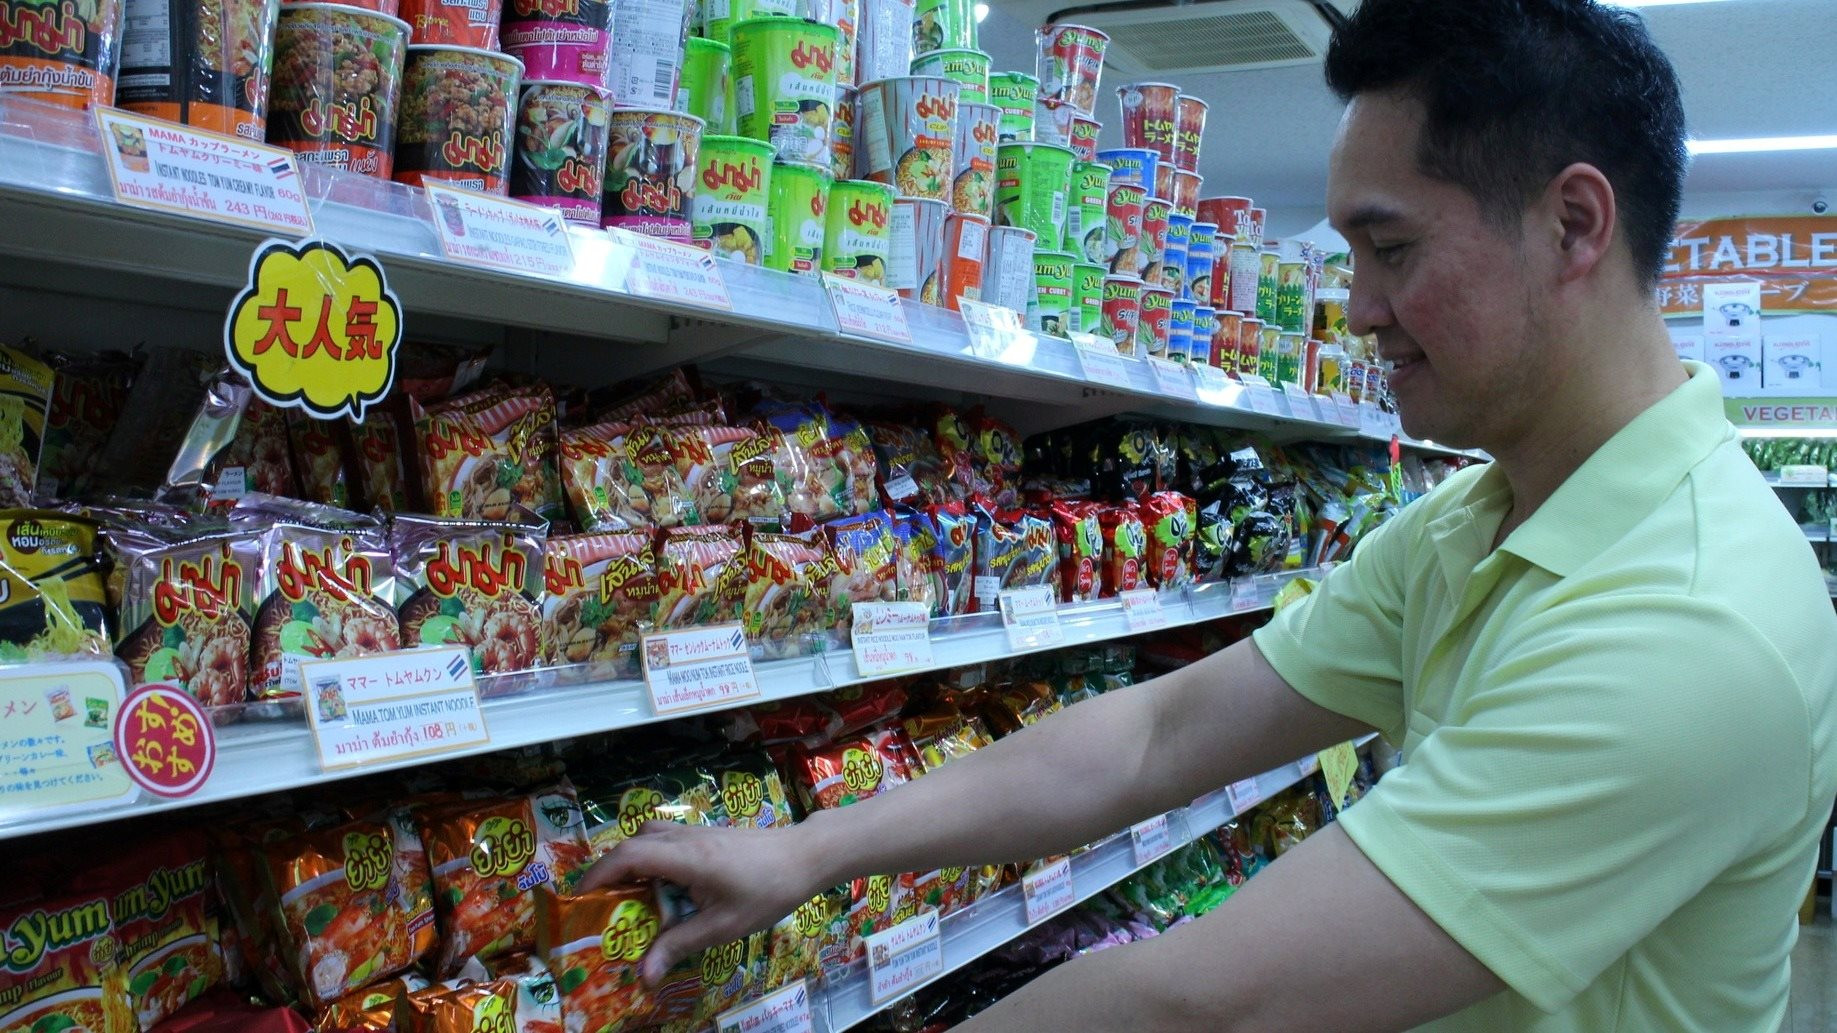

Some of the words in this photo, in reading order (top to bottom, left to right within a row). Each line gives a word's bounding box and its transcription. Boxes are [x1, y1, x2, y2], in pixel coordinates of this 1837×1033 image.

[148, 127, 187, 144] MAMA
[703, 156, 762, 193] มาม่า
[225, 200, 251, 216] 243
[252, 287, 384, 362] 大人気
[1744, 404, 1837, 422] VEGETA
[11, 536, 39, 548] หอม
[276, 536, 373, 603] มาม่า
[424, 532, 527, 600] มาม่า
[153, 543, 243, 628] มาม่า
[346, 676, 378, 690] ママー
[385, 667, 442, 688] トムヤムクン
[352, 708, 377, 726] MAMA
[378, 705, 397, 722] TOM
[397, 703, 414, 720] YUM
[414, 700, 444, 717] INSTANT
[336, 734, 369, 755] มาม่า
[422, 721, 444, 741] 108
[470, 820, 537, 881] ยำยำ
[9, 899, 112, 974] Yum
